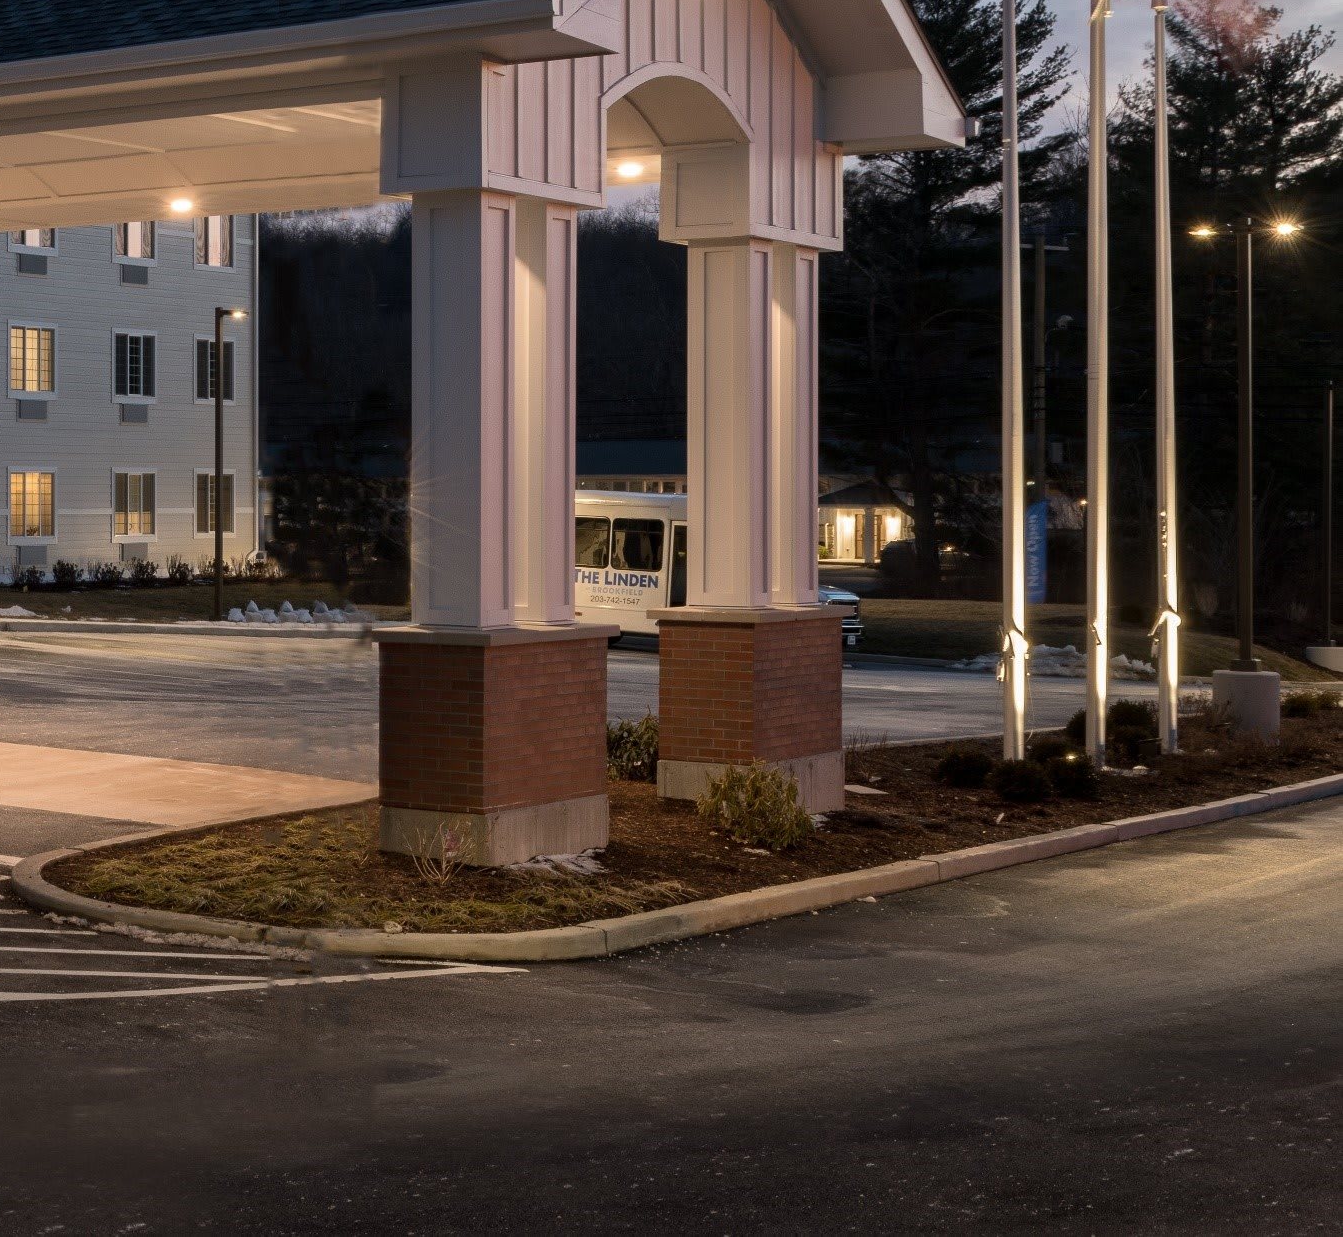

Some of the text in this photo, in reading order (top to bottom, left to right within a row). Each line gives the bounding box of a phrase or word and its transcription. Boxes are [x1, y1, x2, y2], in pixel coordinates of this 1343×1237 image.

[1026, 514, 1042, 587] Now Open
[604, 570, 659, 589] LINDEN
[592, 586, 643, 597] BROOKFIELD
[590, 595, 641, 605] 203-742-1547
